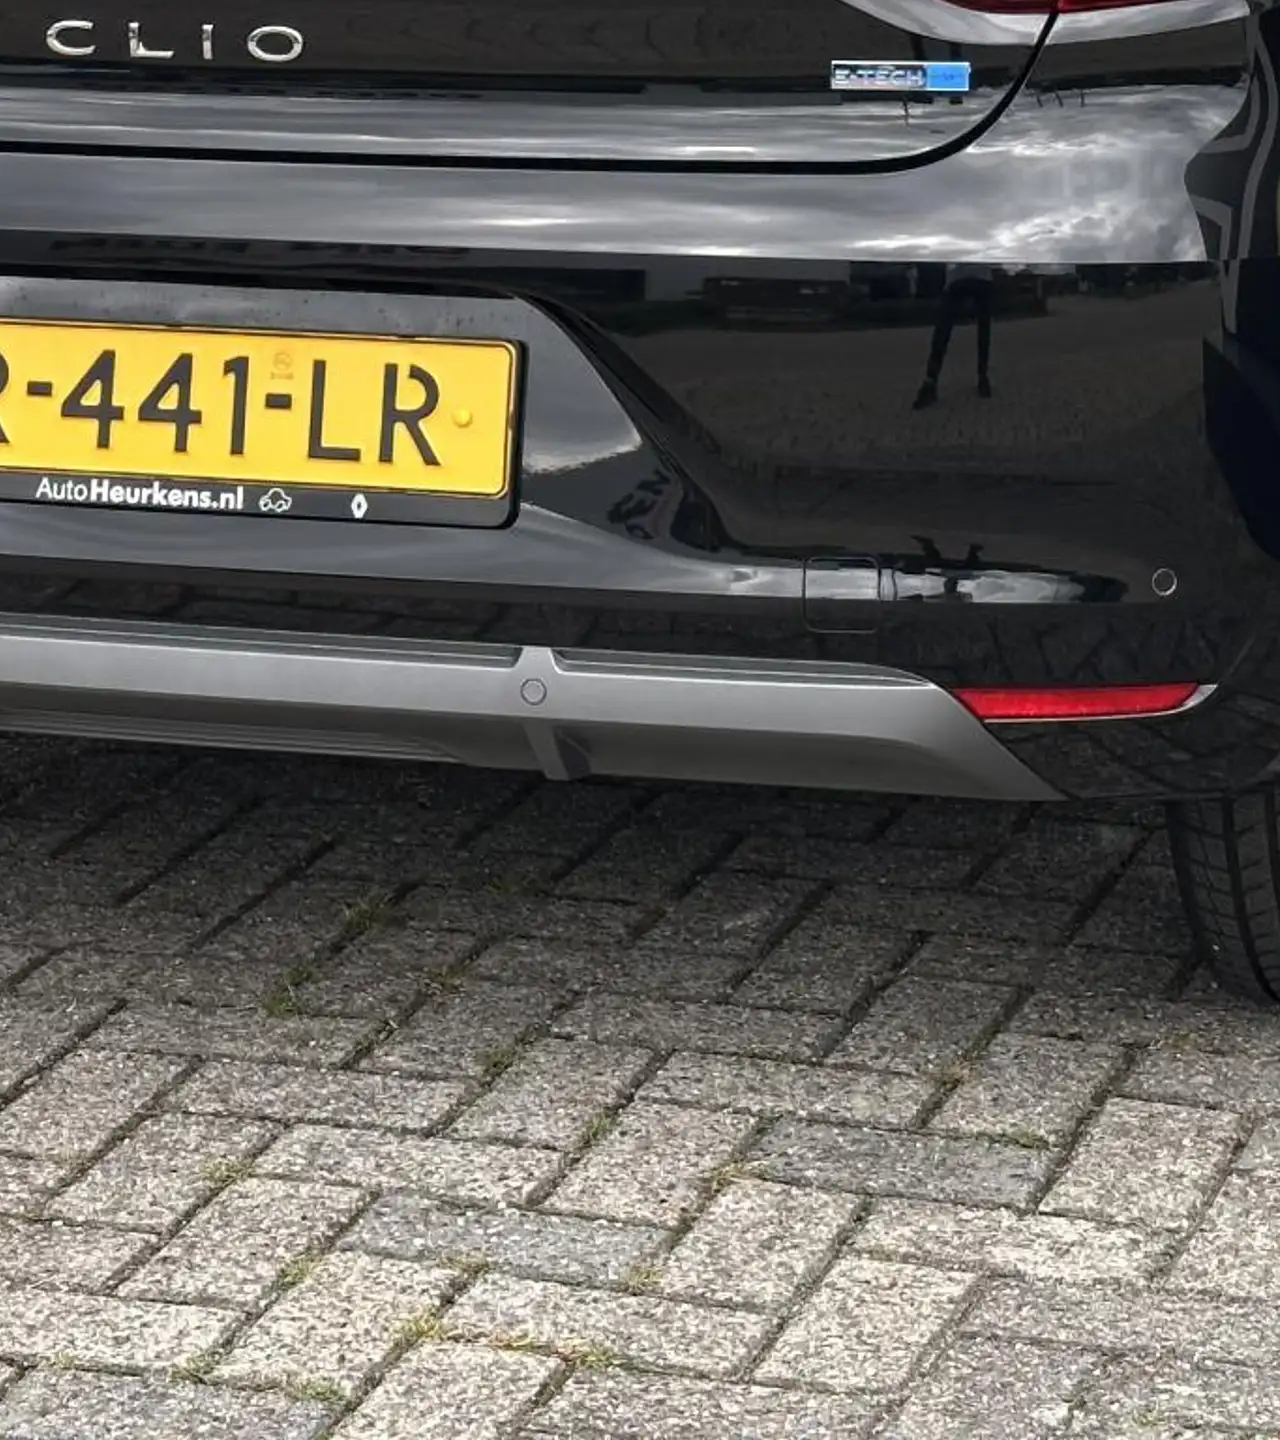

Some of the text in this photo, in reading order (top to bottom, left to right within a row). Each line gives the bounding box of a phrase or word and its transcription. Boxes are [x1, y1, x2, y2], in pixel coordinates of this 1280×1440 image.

[44, 18, 306, 63] CLIO
[833, 68, 926, 87] E-TECH
[35, 476, 244, 512] AutoHeurkens.nl
